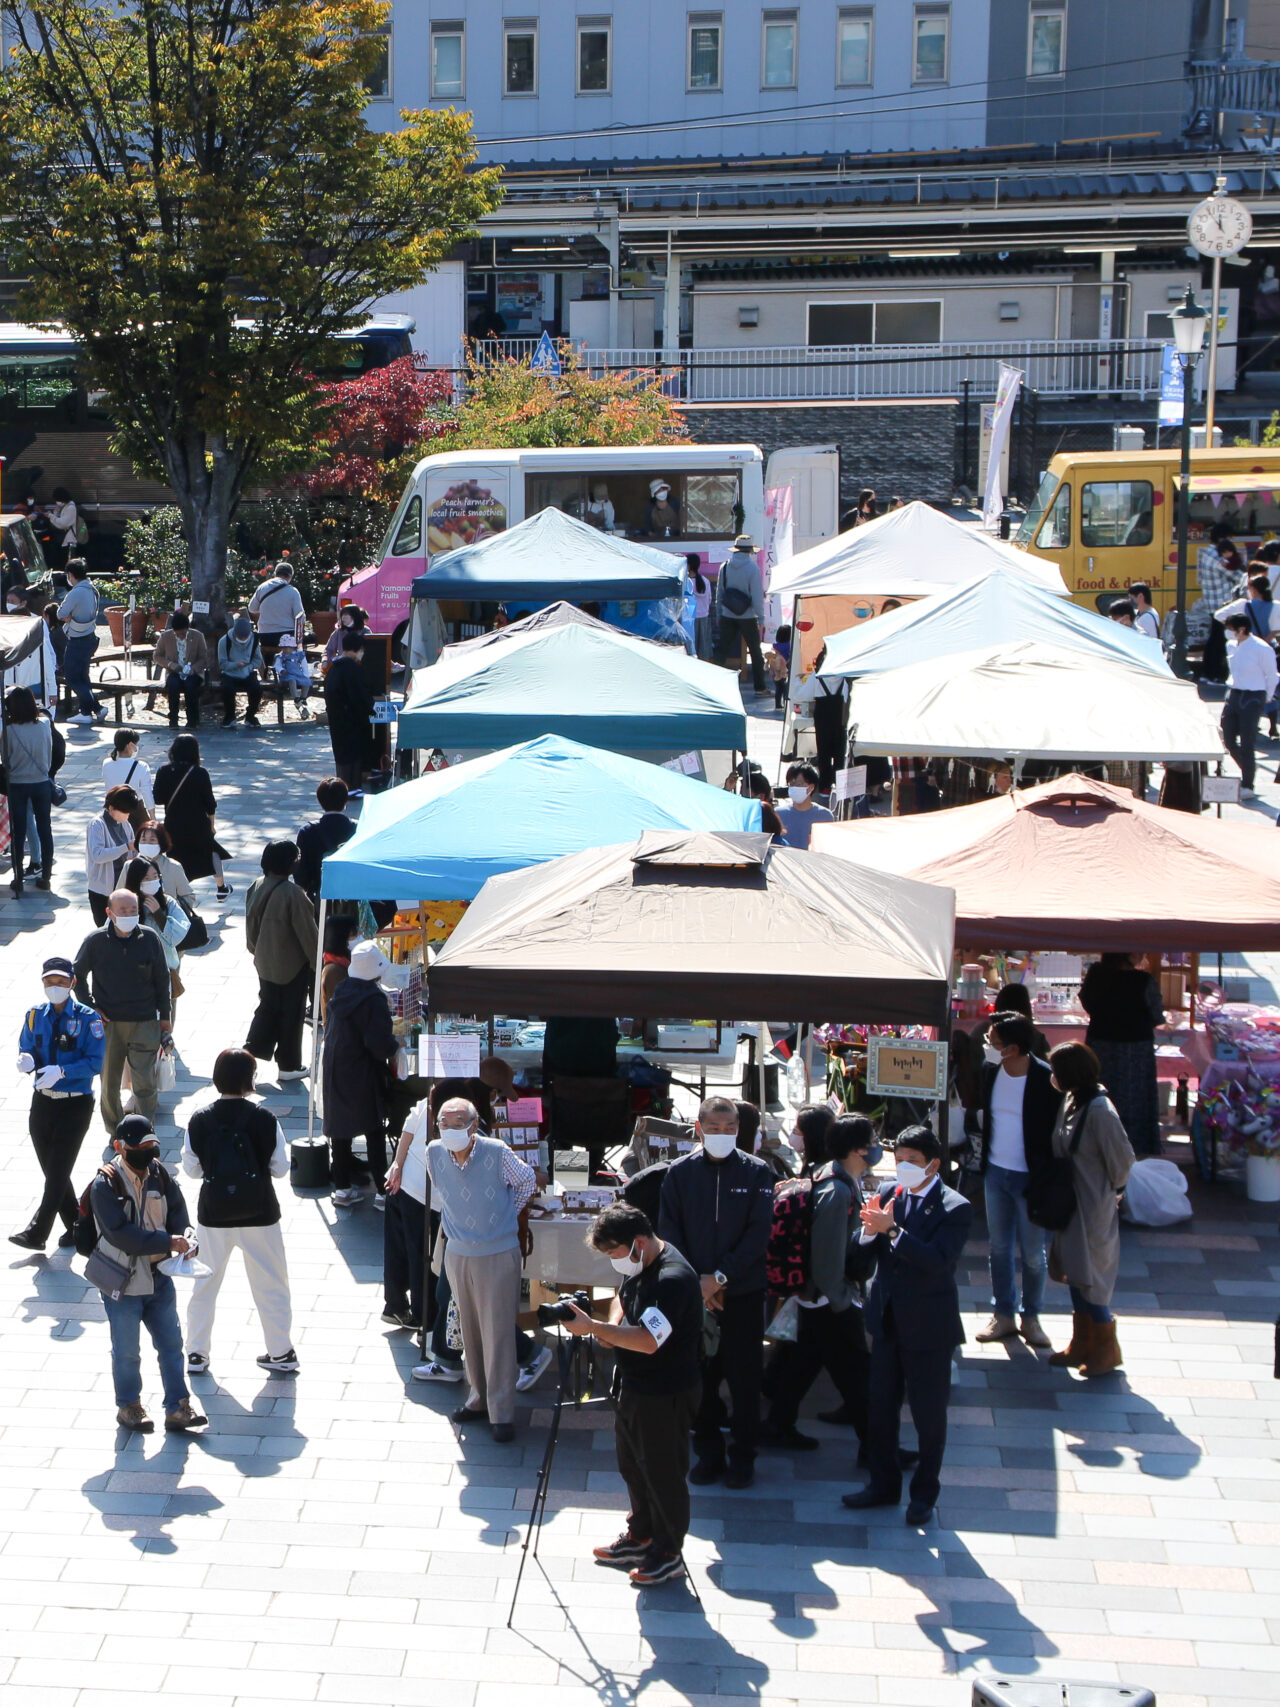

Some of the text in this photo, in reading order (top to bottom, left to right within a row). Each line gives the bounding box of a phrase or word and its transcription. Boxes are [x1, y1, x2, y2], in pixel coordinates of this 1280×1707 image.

[1216, 204, 1226, 213] 12
[1197, 214, 1209, 223] 10
[1235, 212, 1242, 221] 2
[1196, 224, 1203, 233] 9
[1238, 222, 1245, 231] 3
[1200, 233, 1206, 241] 8
[1207, 240, 1214, 249] 7
[1216, 242, 1223, 251] 6
[1227, 240, 1233, 248] 5
[441, 496, 495, 506] Peach farmer's
[431, 507, 504, 517] local fruit smoothies
[1077, 577, 1105, 590] food
[1109, 577, 1120, 589] &
